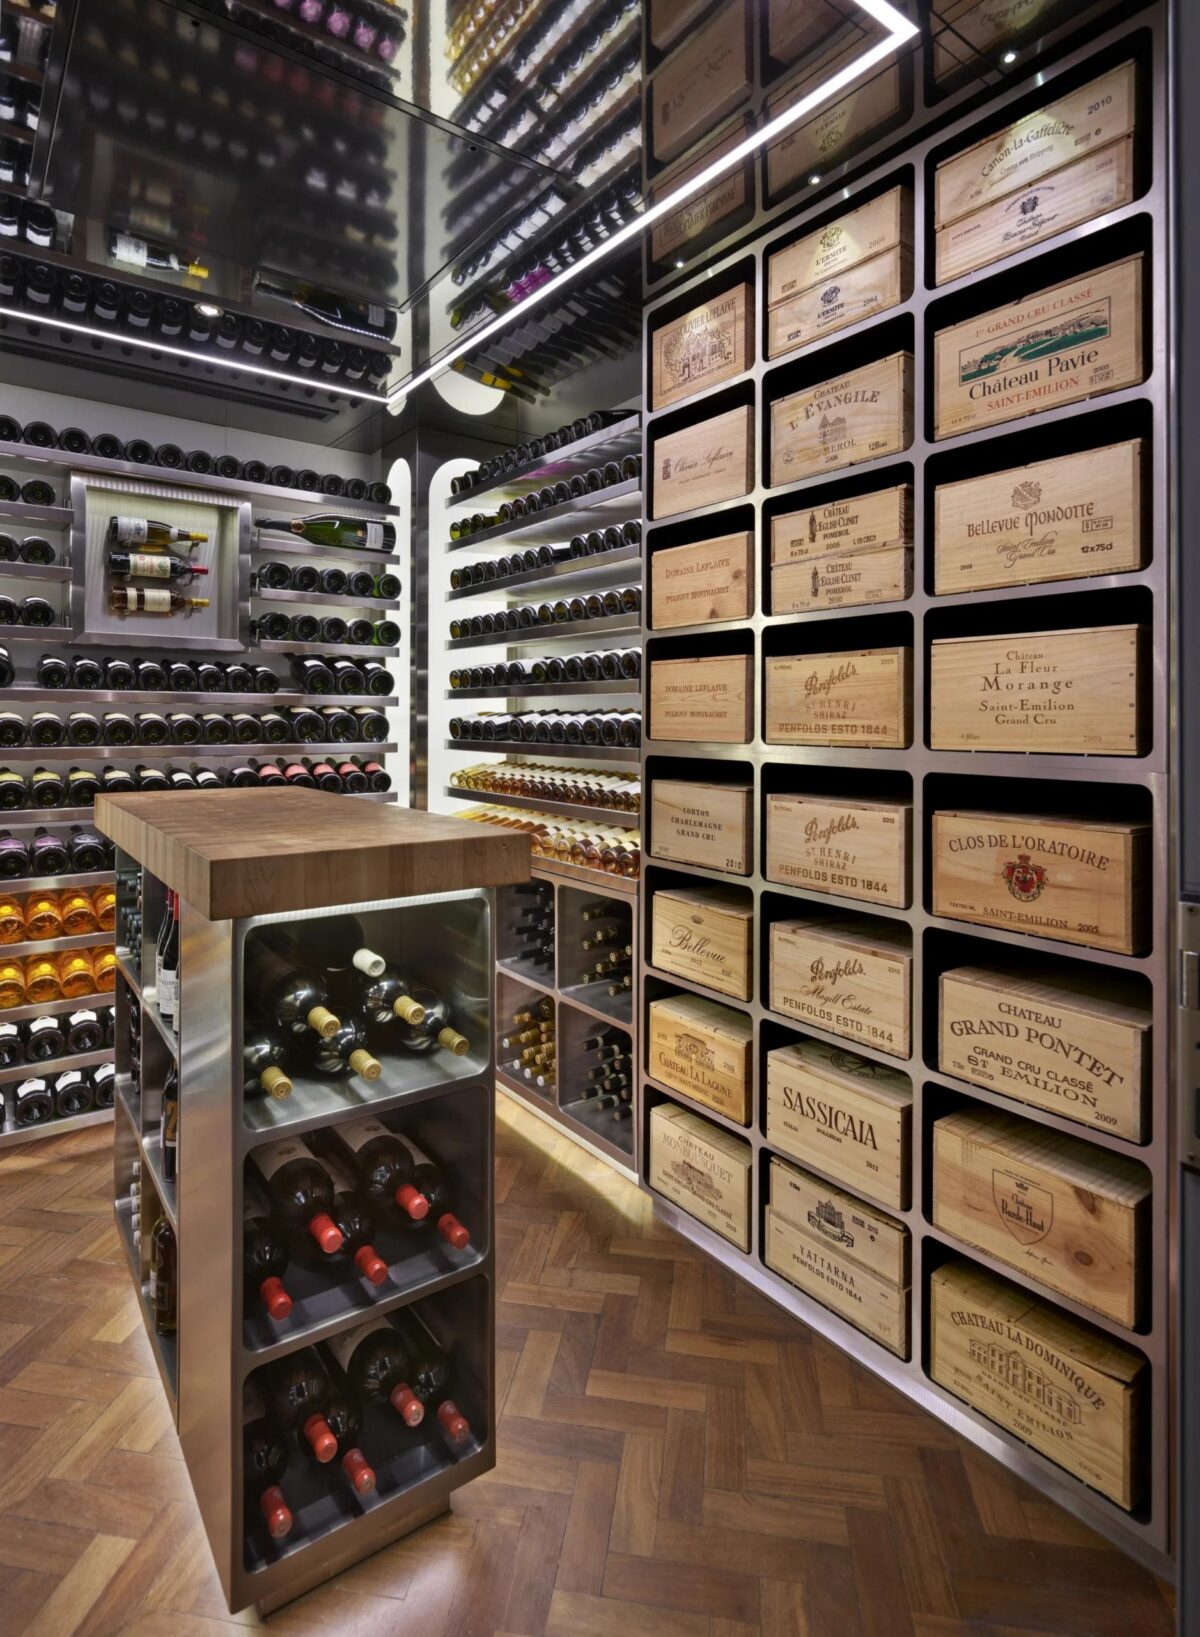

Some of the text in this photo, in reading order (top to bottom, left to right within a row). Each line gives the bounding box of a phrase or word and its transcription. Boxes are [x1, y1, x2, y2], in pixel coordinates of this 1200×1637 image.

[1088, 95, 1112, 116] 2010
[988, 314, 1025, 334] GRAND
[1028, 305, 1050, 318] CRU
[969, 369, 1039, 400] Château
[1048, 350, 1099, 377] Pavie
[986, 376, 1080, 412] SAINT-EMILION
[823, 529, 850, 540] POMEROL
[826, 586, 852, 595] POMEROL
[994, 661, 1058, 674] La Fleur
[1006, 650, 1044, 661] Château
[980, 676, 1073, 694] Morange
[820, 700, 856, 712] HENRI
[978, 699, 1075, 712] Saint-Emilion
[778, 723, 888, 735] PENFOLDS ESTD 1844
[994, 714, 1056, 725] Grand Cru
[671, 816, 723, 831] CHARLEMAGNE
[682, 807, 710, 817] CORTON
[677, 829, 716, 841] GRAND CRU
[814, 858, 848, 871] SHIRAZ
[820, 847, 856, 864] HENRI
[949, 834, 1110, 871] CLOS DE L'ORATOIRE
[778, 864, 888, 893] PENFOLDS ESTD 1844
[983, 907, 1068, 929] SAINT-EMILION
[1078, 923, 1099, 934] 2005
[669, 924, 726, 964] Bellevue
[800, 985, 874, 1016] Magill Estate
[783, 996, 893, 1043] PENFOLDS ESTD 1844
[998, 1002, 1062, 1029] CHATEAU
[950, 1020, 1124, 1088] GRAND PONTET
[973, 1046, 1093, 1093] GRAND CRU CLASSÉ
[702, 1072, 733, 1098] LAGUNE
[1000, 1065, 1099, 1108] EMILION
[783, 1086, 879, 1150] SASSICAIA
[1095, 1111, 1118, 1126] 2009
[662, 1134, 733, 1184] MONBOUSQUET
[678, 1136, 714, 1161] CHATEAU
[1001, 1199, 1044, 1232] Barde-Haut
[792, 1255, 862, 1303] PENFOLDS ESTD 1844
[800, 1245, 856, 1288] YATTARNA
[951, 1311, 1106, 1410] CHATEAU LA DOMINIQUE
[1012, 1418, 1033, 1436] 2009
